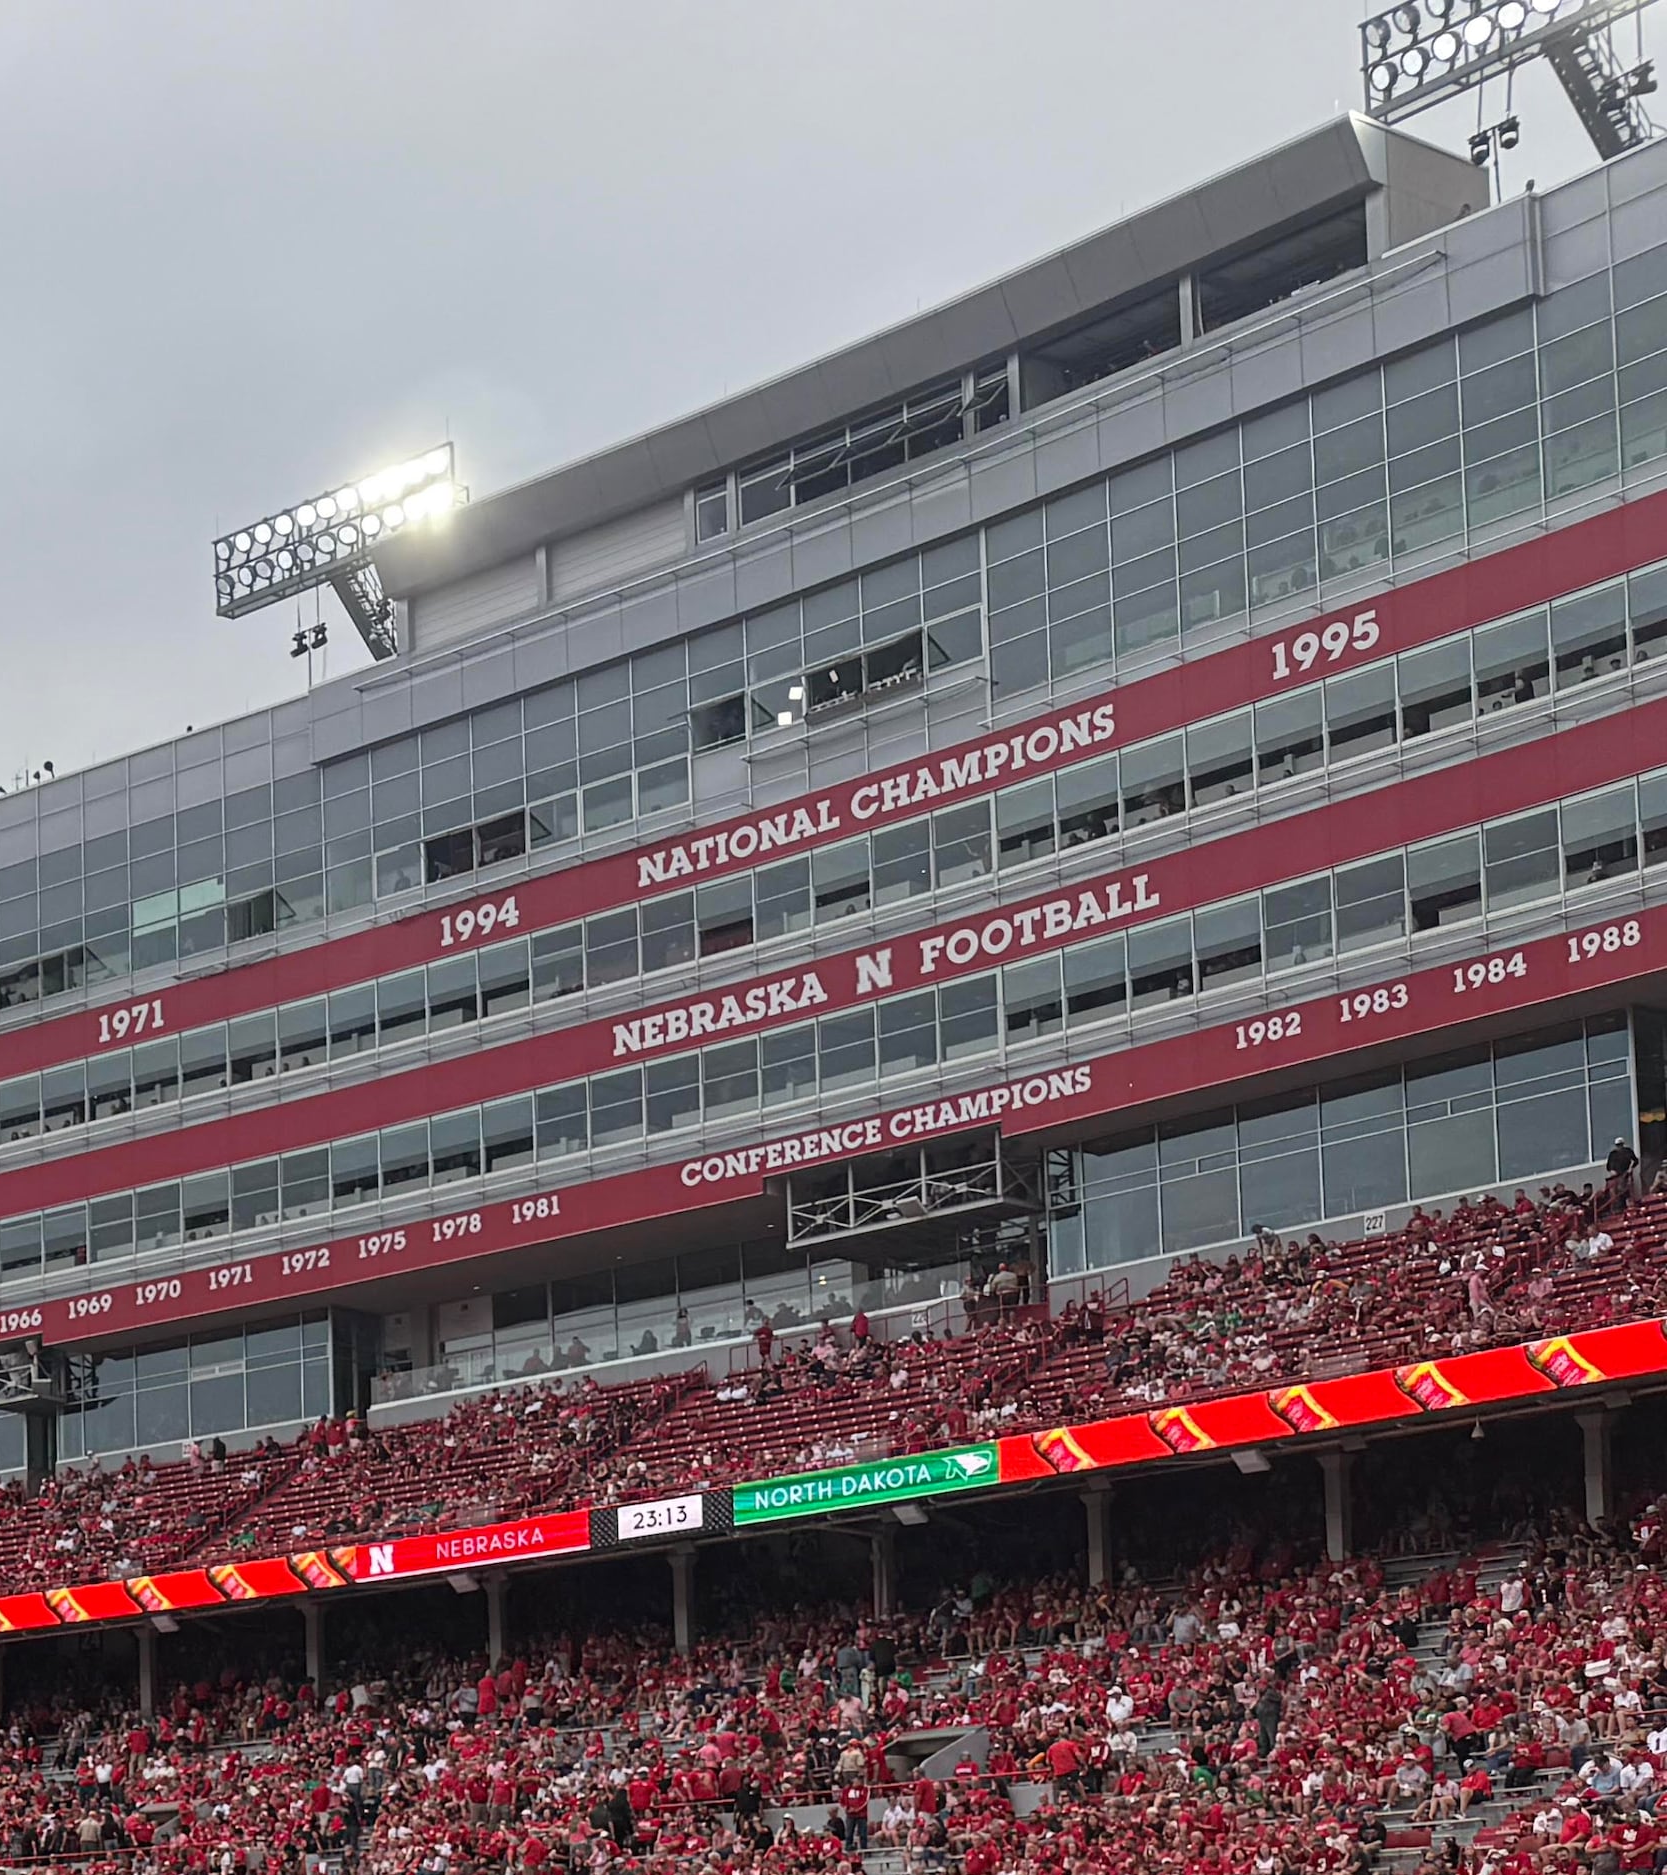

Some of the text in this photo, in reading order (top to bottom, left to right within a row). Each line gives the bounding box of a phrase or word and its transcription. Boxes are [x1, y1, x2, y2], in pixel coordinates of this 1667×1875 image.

[1270, 610, 1381, 681] 1995
[636, 703, 1117, 888] NATIONAL CHAMPIONS
[440, 896, 520, 947] 1994
[611, 873, 1161, 1058] NEBRASKA N FOOTBALL
[98, 1000, 165, 1044] 1971
[0, 1309, 42, 1334] 1966
[68, 1294, 113, 1319] 1969
[135, 1279, 181, 1306] 1970
[208, 1265, 253, 1290] 1971
[281, 1248, 330, 1275] 1972
[357, 1231, 407, 1259] 1975
[432, 1214, 482, 1242] 1978
[511, 1196, 560, 1225] 1981
[1234, 1012, 1301, 1050] 1982
[1339, 984, 1409, 1023] 1983
[1452, 952, 1527, 993] 1984
[1567, 920, 1642, 963] 1988
[680, 1065, 1092, 1188] CONFERENCE CHAMPIONS
[753, 1463, 932, 1511] NORTH DAKOTA
[436, 1526, 544, 1561] NEBRASKA
[632, 1505, 688, 1531] 23:13
[369, 1545, 395, 1575] N
